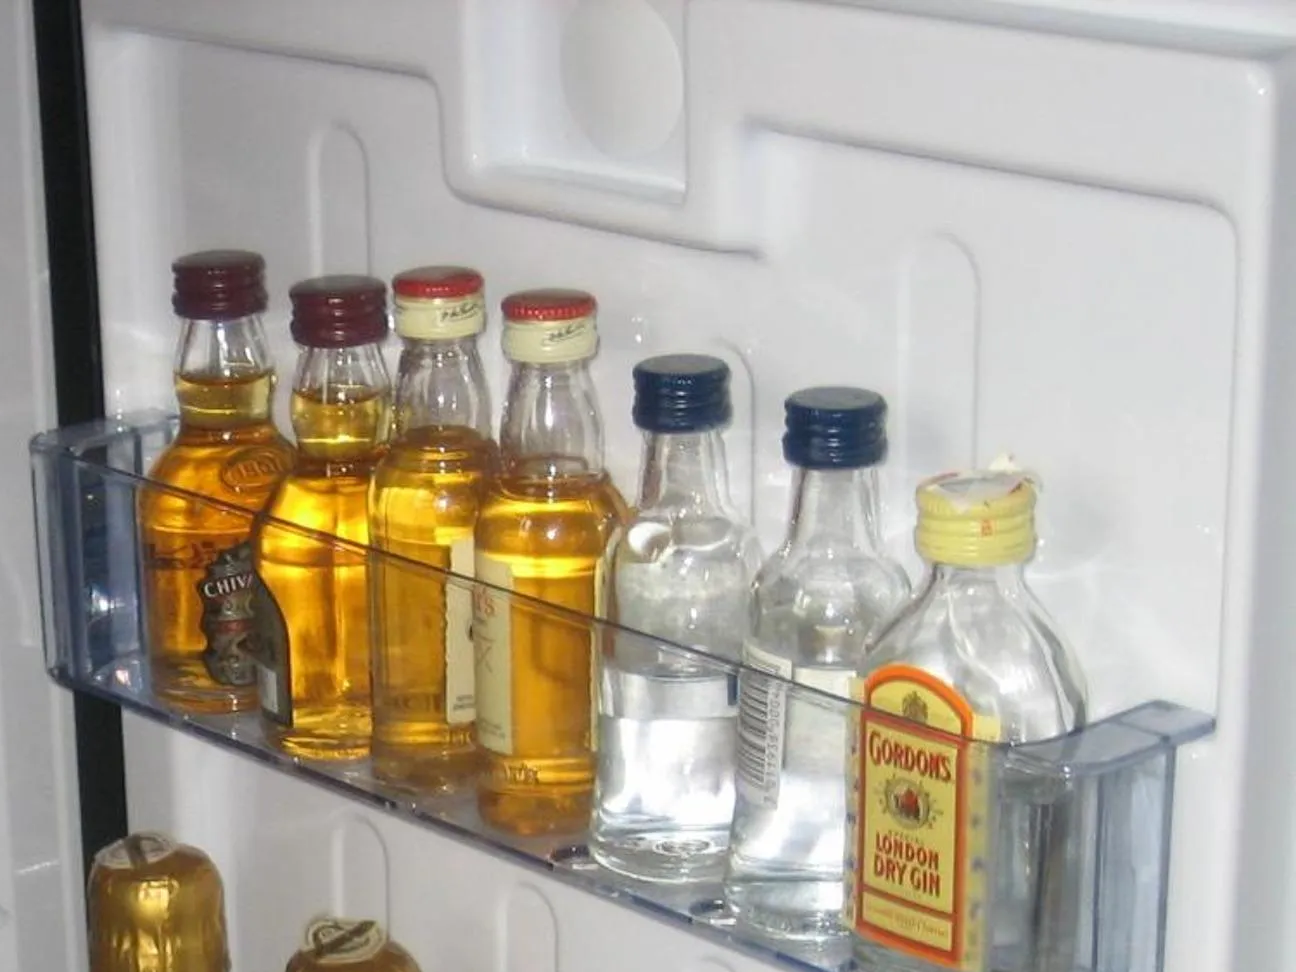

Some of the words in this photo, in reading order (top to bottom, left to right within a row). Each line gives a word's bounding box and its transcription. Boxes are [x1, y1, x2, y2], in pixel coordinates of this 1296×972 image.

[876, 831, 939, 872] LONDON
[874, 853, 907, 886] DRY
[910, 866, 940, 898] GIN
